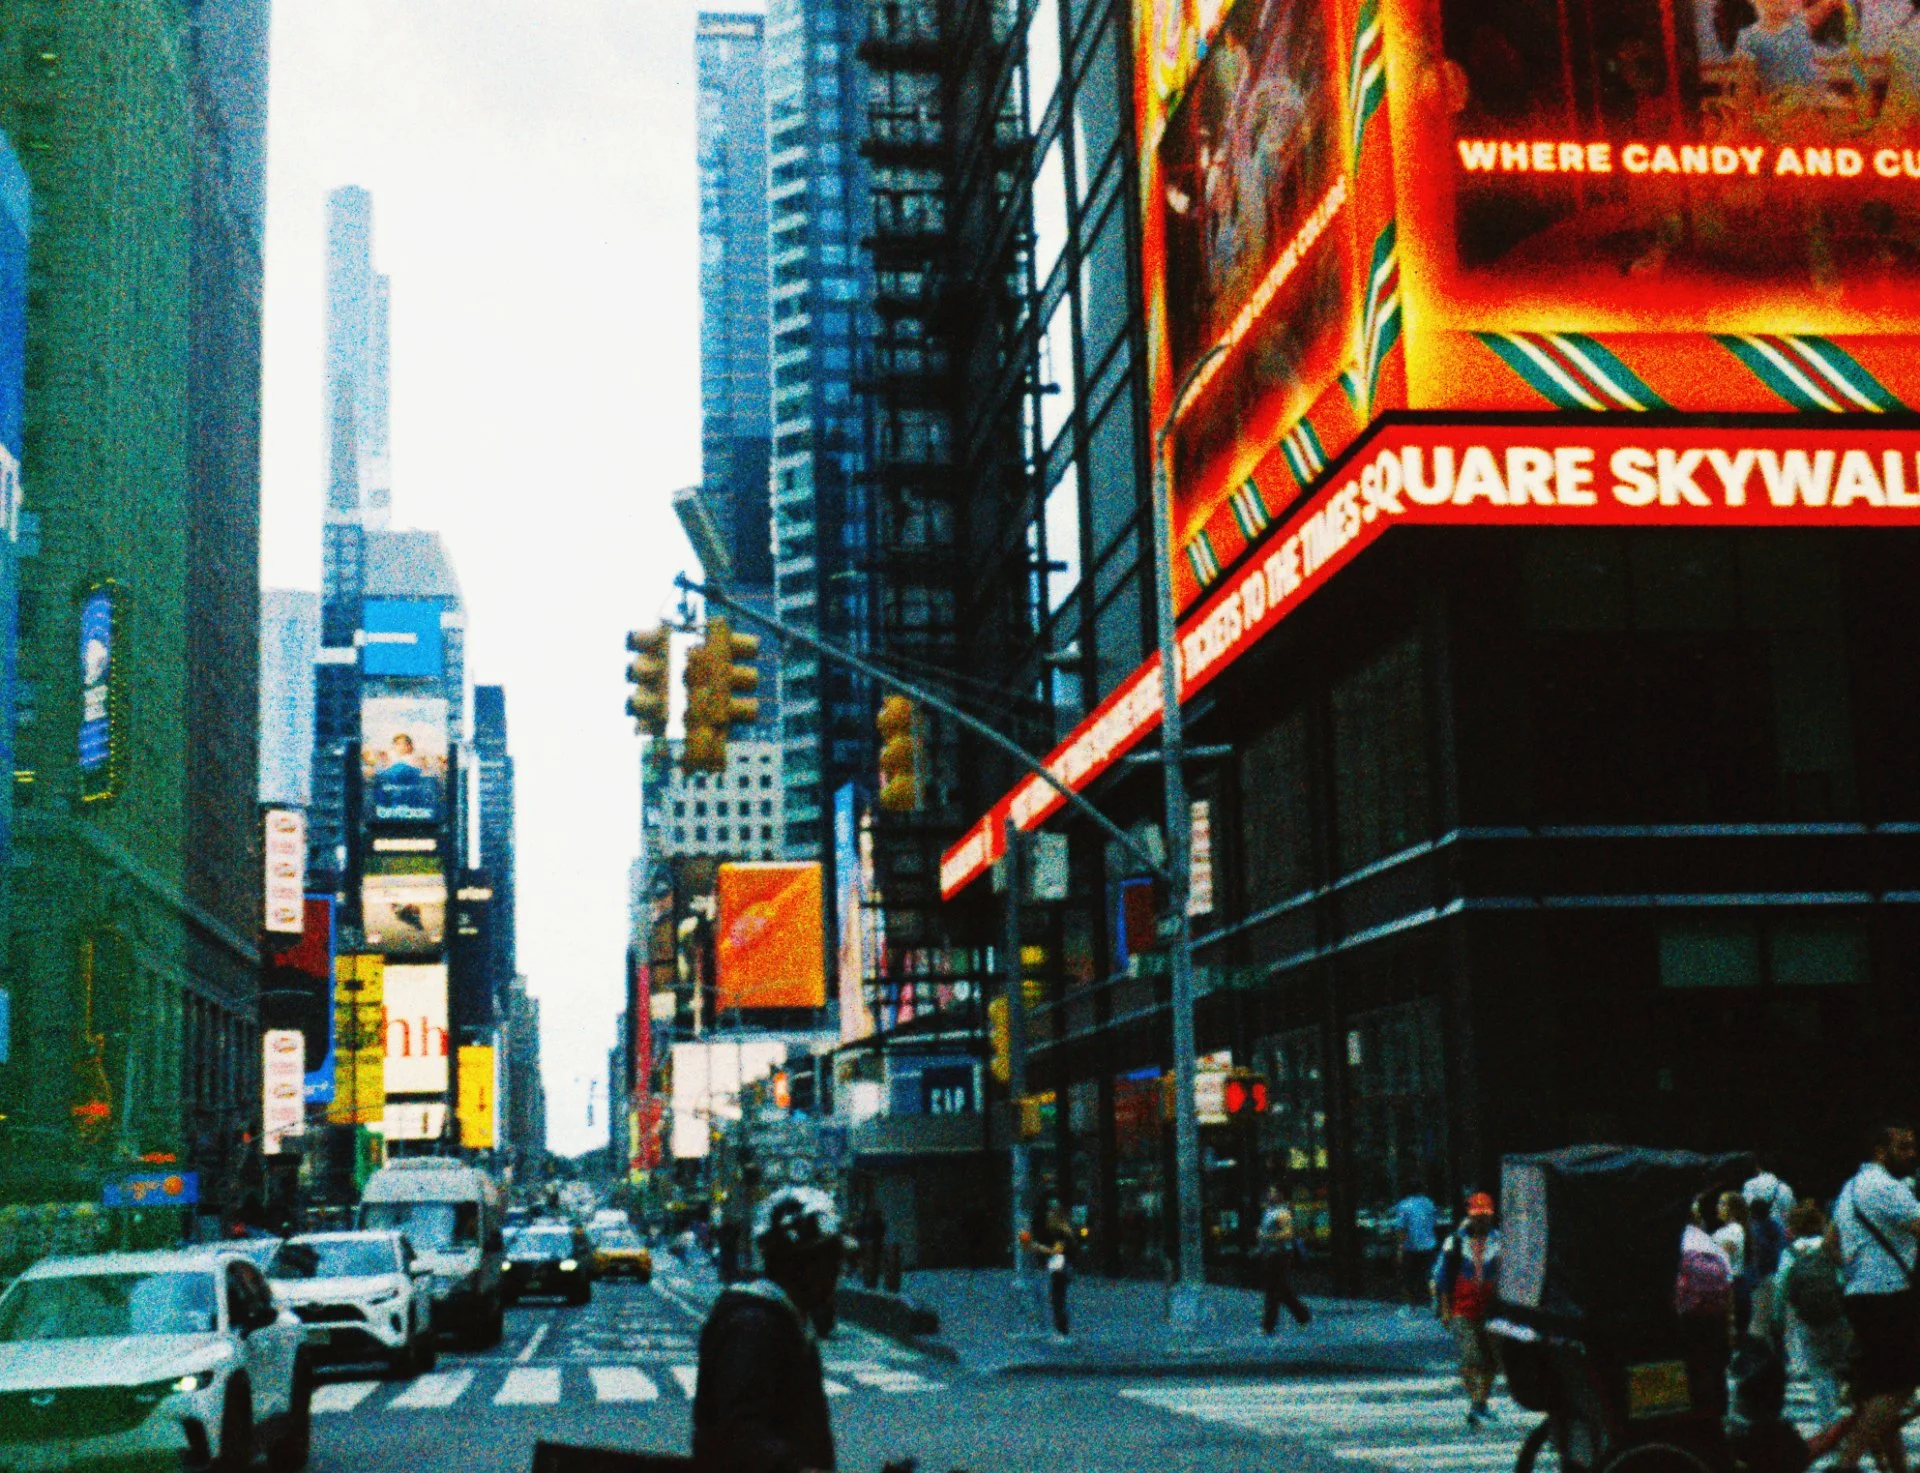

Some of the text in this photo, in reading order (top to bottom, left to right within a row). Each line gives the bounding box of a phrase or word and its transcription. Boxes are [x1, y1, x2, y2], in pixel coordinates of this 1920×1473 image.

[1458, 139, 1612, 173] WHERE
[1622, 143, 1764, 175] CANDY
[1775, 147, 1863, 177] AND
[1241, 570, 1266, 630] TO
[1264, 534, 1301, 609] THE
[1299, 480, 1360, 577] TIMES
[1361, 446, 1598, 523] SQUARE
[1610, 449, 1920, 507] SKYWAL
